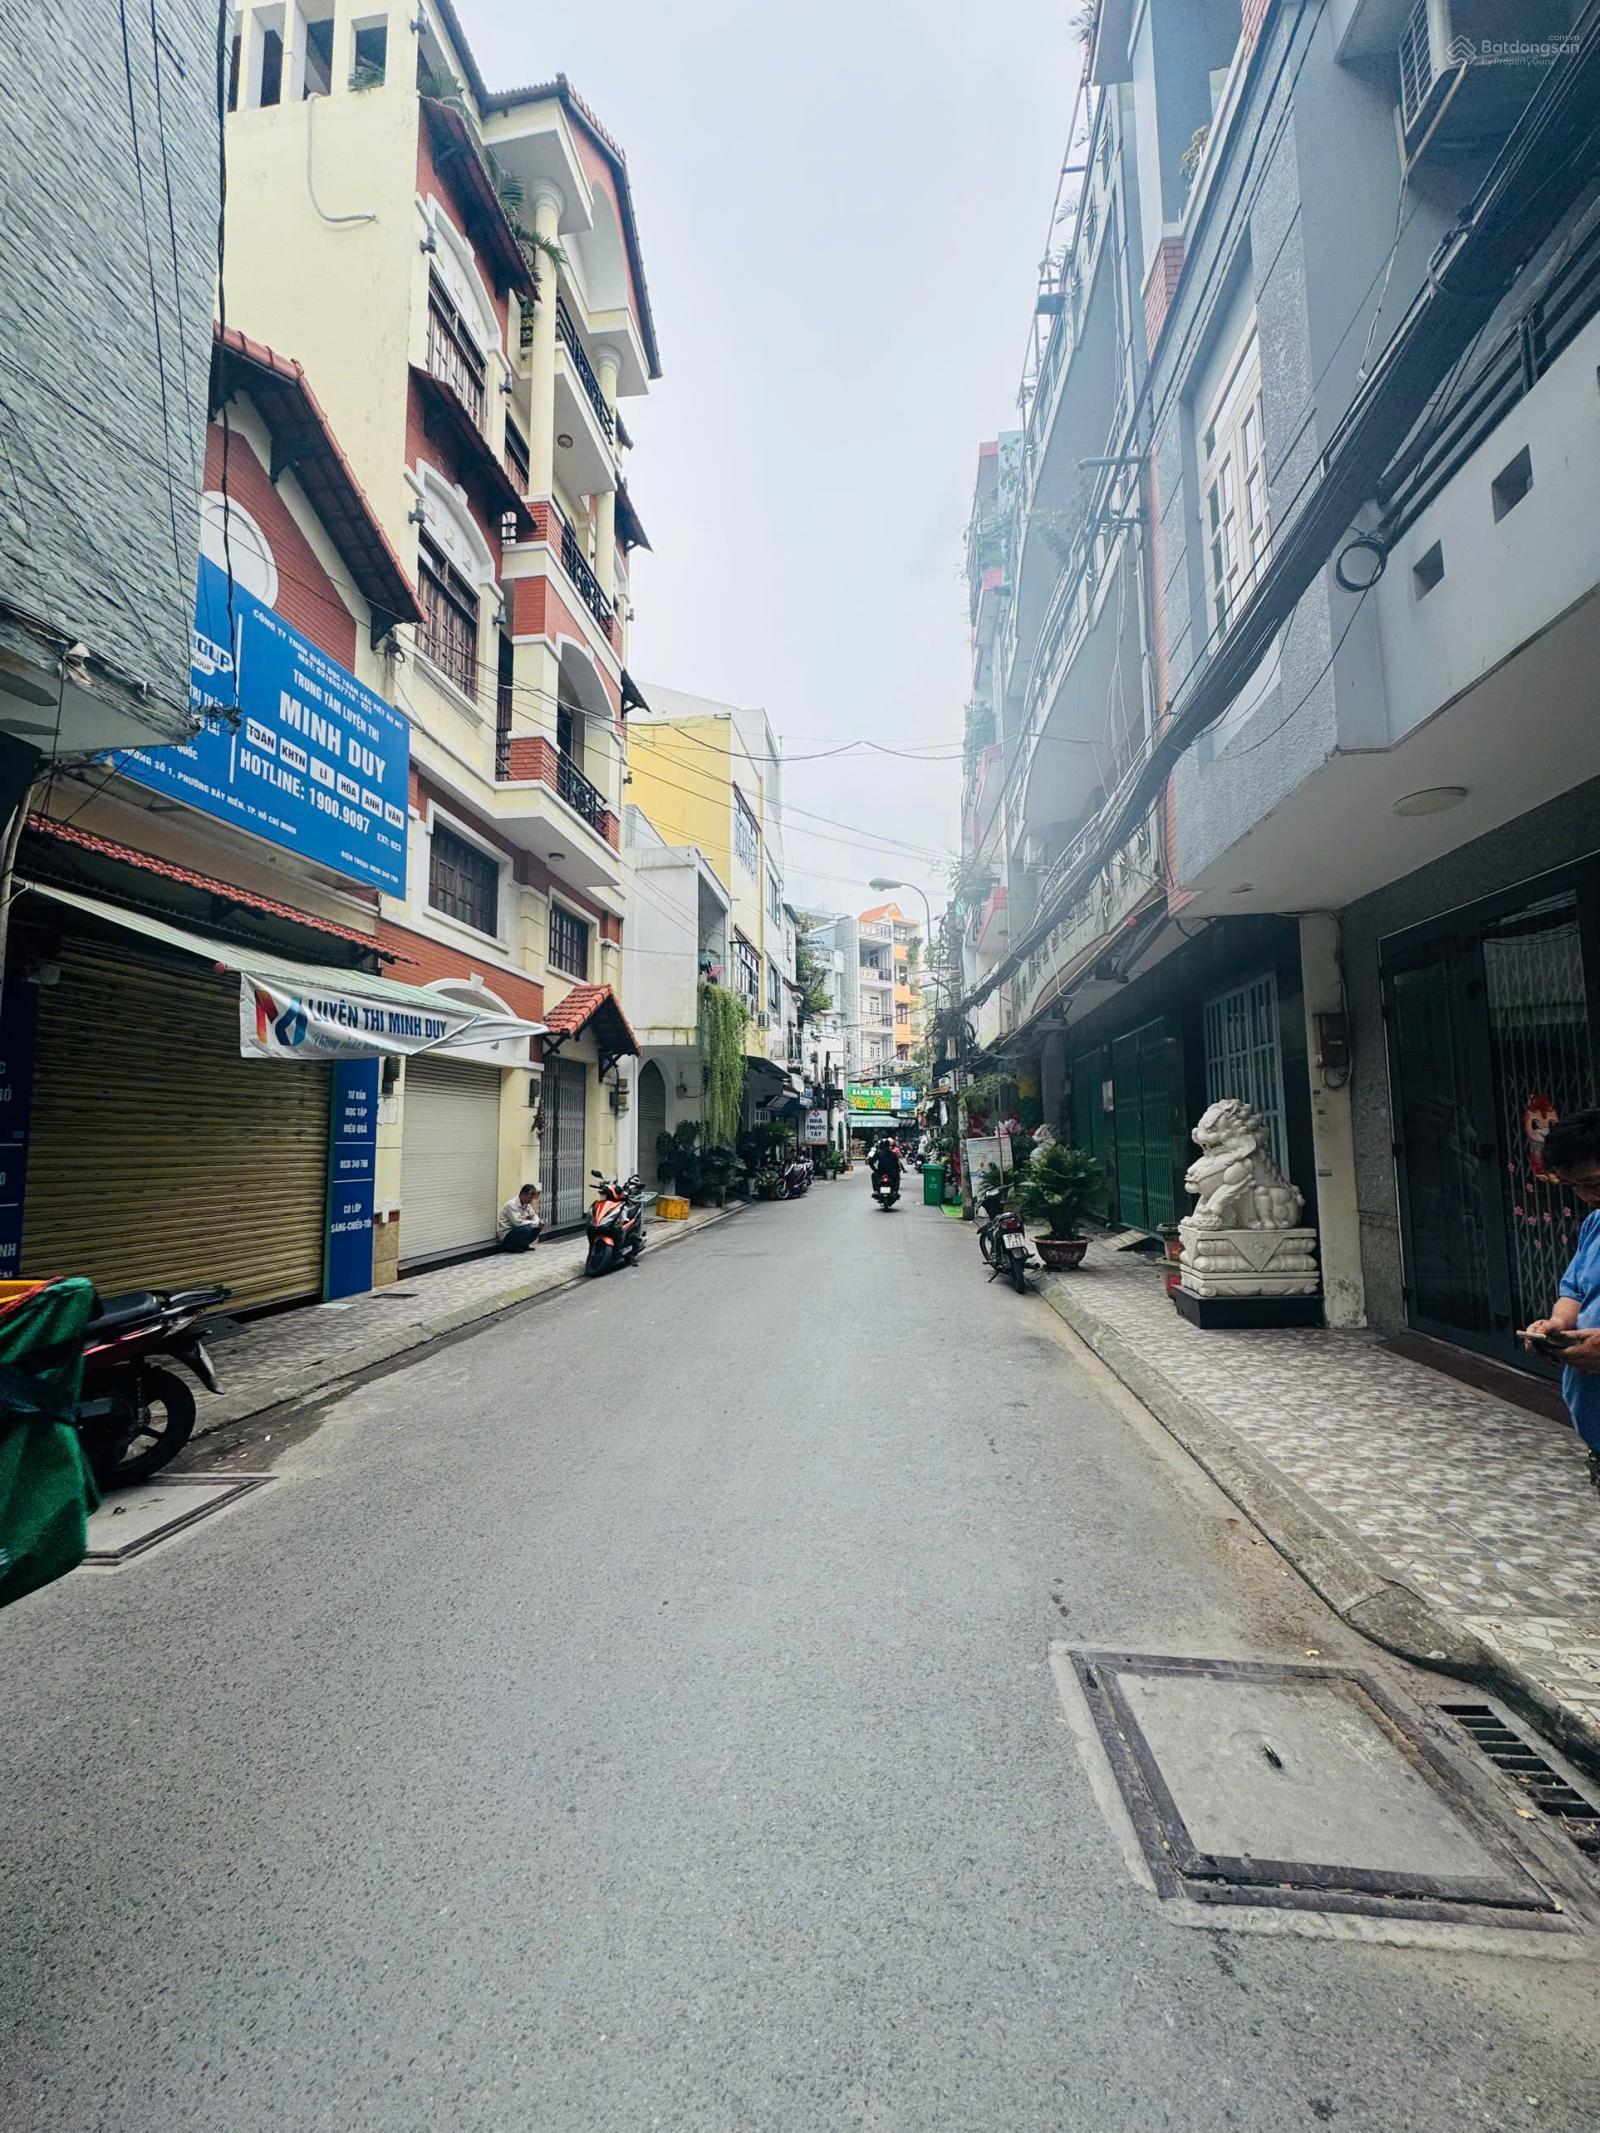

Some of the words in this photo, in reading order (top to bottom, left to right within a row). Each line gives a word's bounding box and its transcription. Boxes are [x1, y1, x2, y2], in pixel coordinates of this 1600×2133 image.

[252, 608, 276, 632] CÔNG
[278, 628, 288, 640] TY
[279, 689, 342, 757] MINH
[348, 737, 387, 784] DUY
[293, 668, 322, 701] TRUNG
[323, 690, 342, 715] TÂM
[342, 705, 367, 736] LUYỆN
[367, 724, 380, 743] THI
[240, 747, 306, 801] HOTLINE:
[309, 787, 371, 835] 1900.9097
[248, 722, 275, 749] TOÁN
[281, 744, 307, 768] KHTN
[364, 794, 380, 812] ANH
[362, 1007, 384, 1033] THI
[388, 1014, 422, 1038] MINH
[424, 1020, 447, 1040] DUY
[902, 1090, 917, 1101] 138
